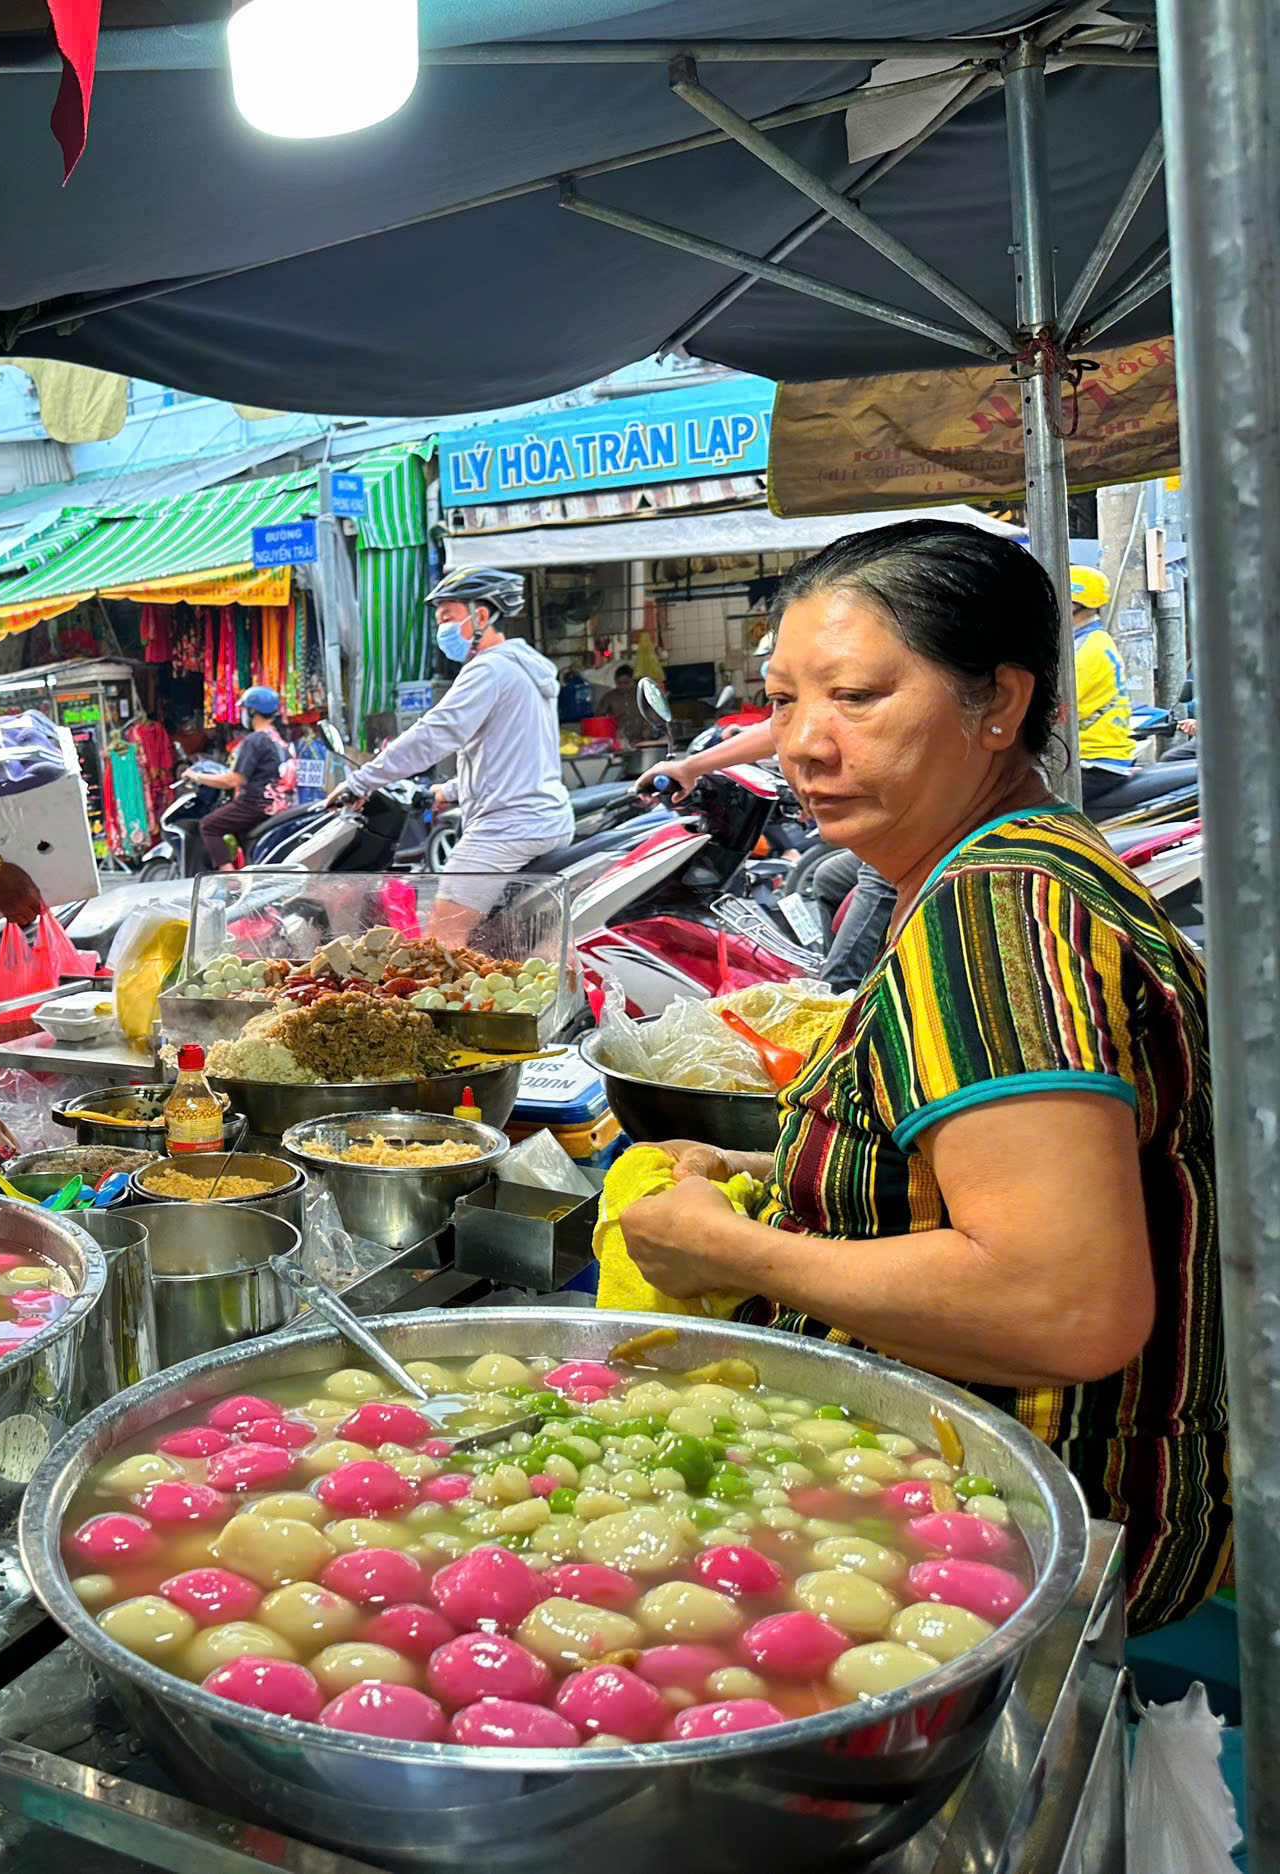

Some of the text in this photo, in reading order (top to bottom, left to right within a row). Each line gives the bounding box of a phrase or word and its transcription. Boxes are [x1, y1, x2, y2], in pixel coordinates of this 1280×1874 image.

[449, 442, 493, 494] LÝ
[498, 434, 575, 489] HÒA
[573, 421, 678, 479] TRÂN
[686, 412, 759, 467] LẠP
